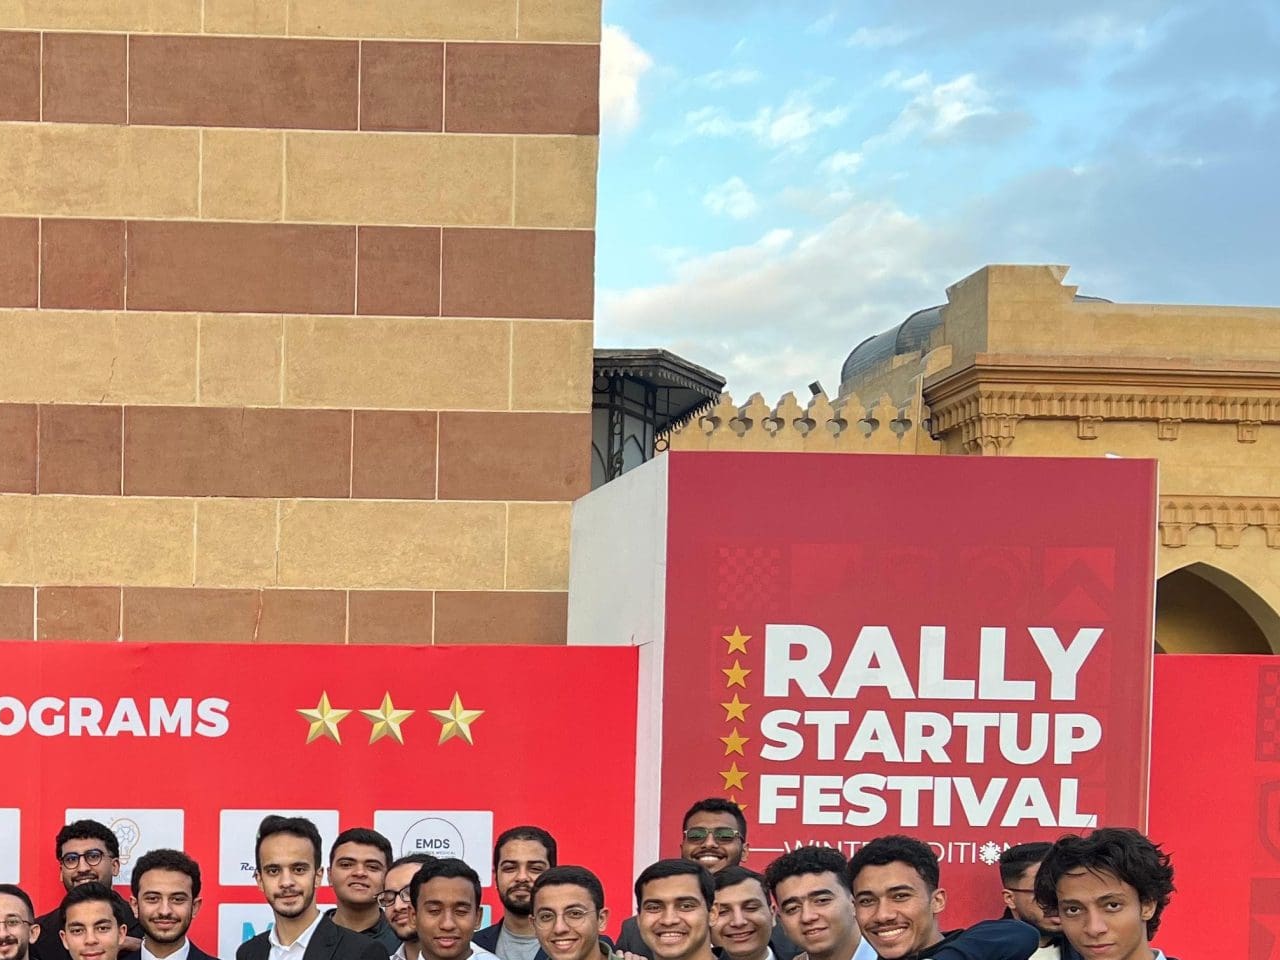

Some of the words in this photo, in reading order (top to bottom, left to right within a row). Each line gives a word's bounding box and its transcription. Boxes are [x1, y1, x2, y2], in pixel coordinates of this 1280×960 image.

[763, 623, 1105, 701] RALLY
[759, 709, 1102, 765] STARTUP
[758, 773, 1098, 829] FESTIVAL
[415, 838, 451, 849] EMDS
